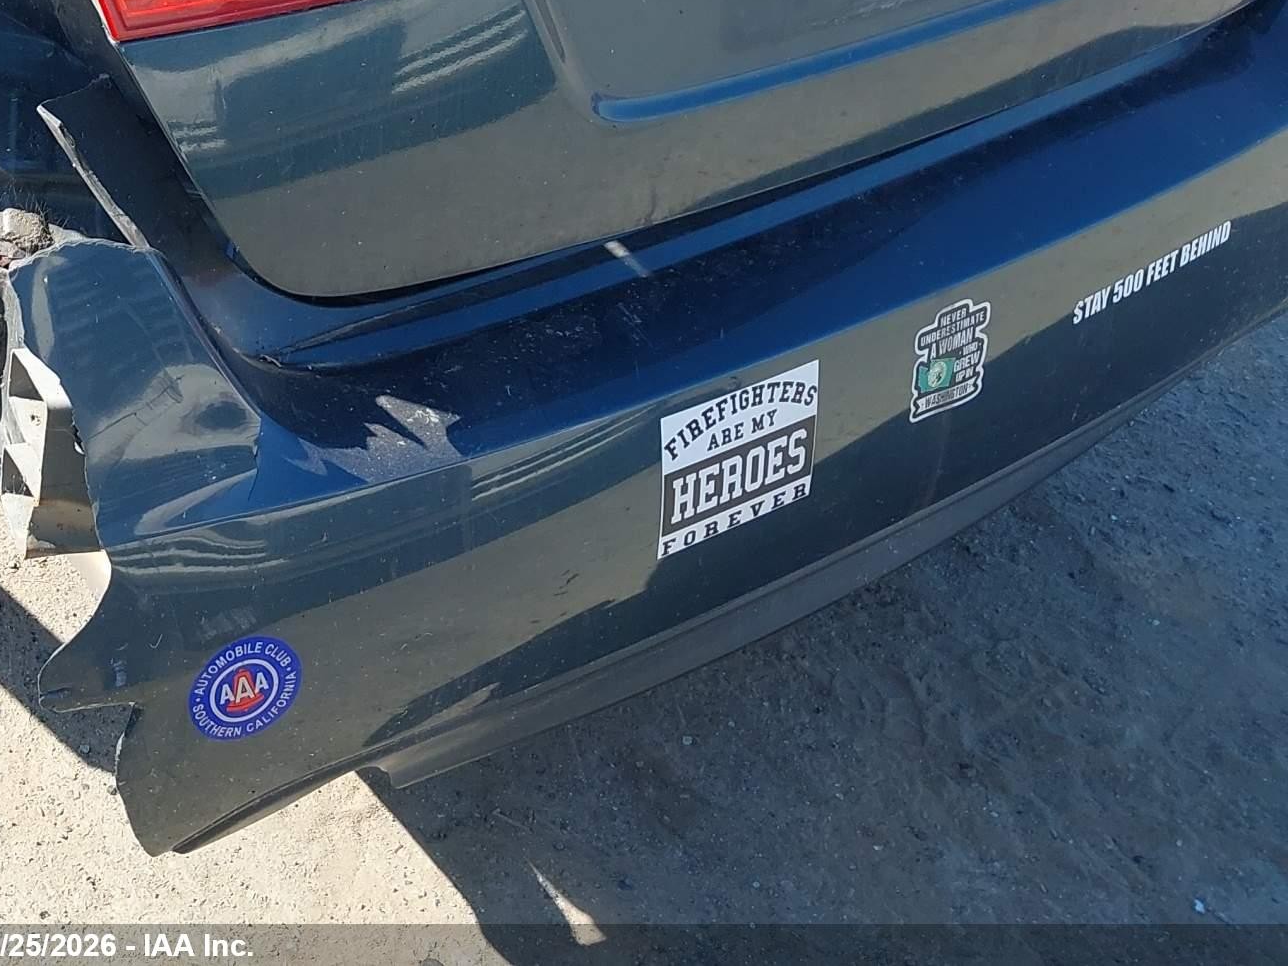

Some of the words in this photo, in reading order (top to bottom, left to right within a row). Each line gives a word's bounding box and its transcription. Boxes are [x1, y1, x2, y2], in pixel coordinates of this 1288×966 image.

[1072, 285, 1112, 325] STAY
[1112, 267, 1145, 304] 500
[1145, 248, 1179, 286] FEET
[1179, 220, 1232, 268] BEHIND
[921, 311, 985, 346] UNDERESTIMATE
[941, 308, 966, 327] NEVER
[930, 343, 937, 359] A
[939, 327, 973, 355] WOMAN
[963, 342, 977, 355] WHO
[954, 352, 980, 372] GREW
[956, 372, 965, 382] UP
[925, 383, 969, 408] WASHINGTON
[663, 380, 818, 461] FIREFIGHTERS
[706, 422, 744, 452] ARE
[751, 409, 778, 434] MY
[670, 428, 808, 525] HEROES
[661, 482, 808, 556] FOREVER
[194, 641, 264, 696] AUTOMOBILE
[264, 643, 292, 667] CLUB
[192, 703, 242, 737] SOUTHERN
[246, 670, 297, 733] CALIFORNIA
[219, 671, 269, 705] AAA
